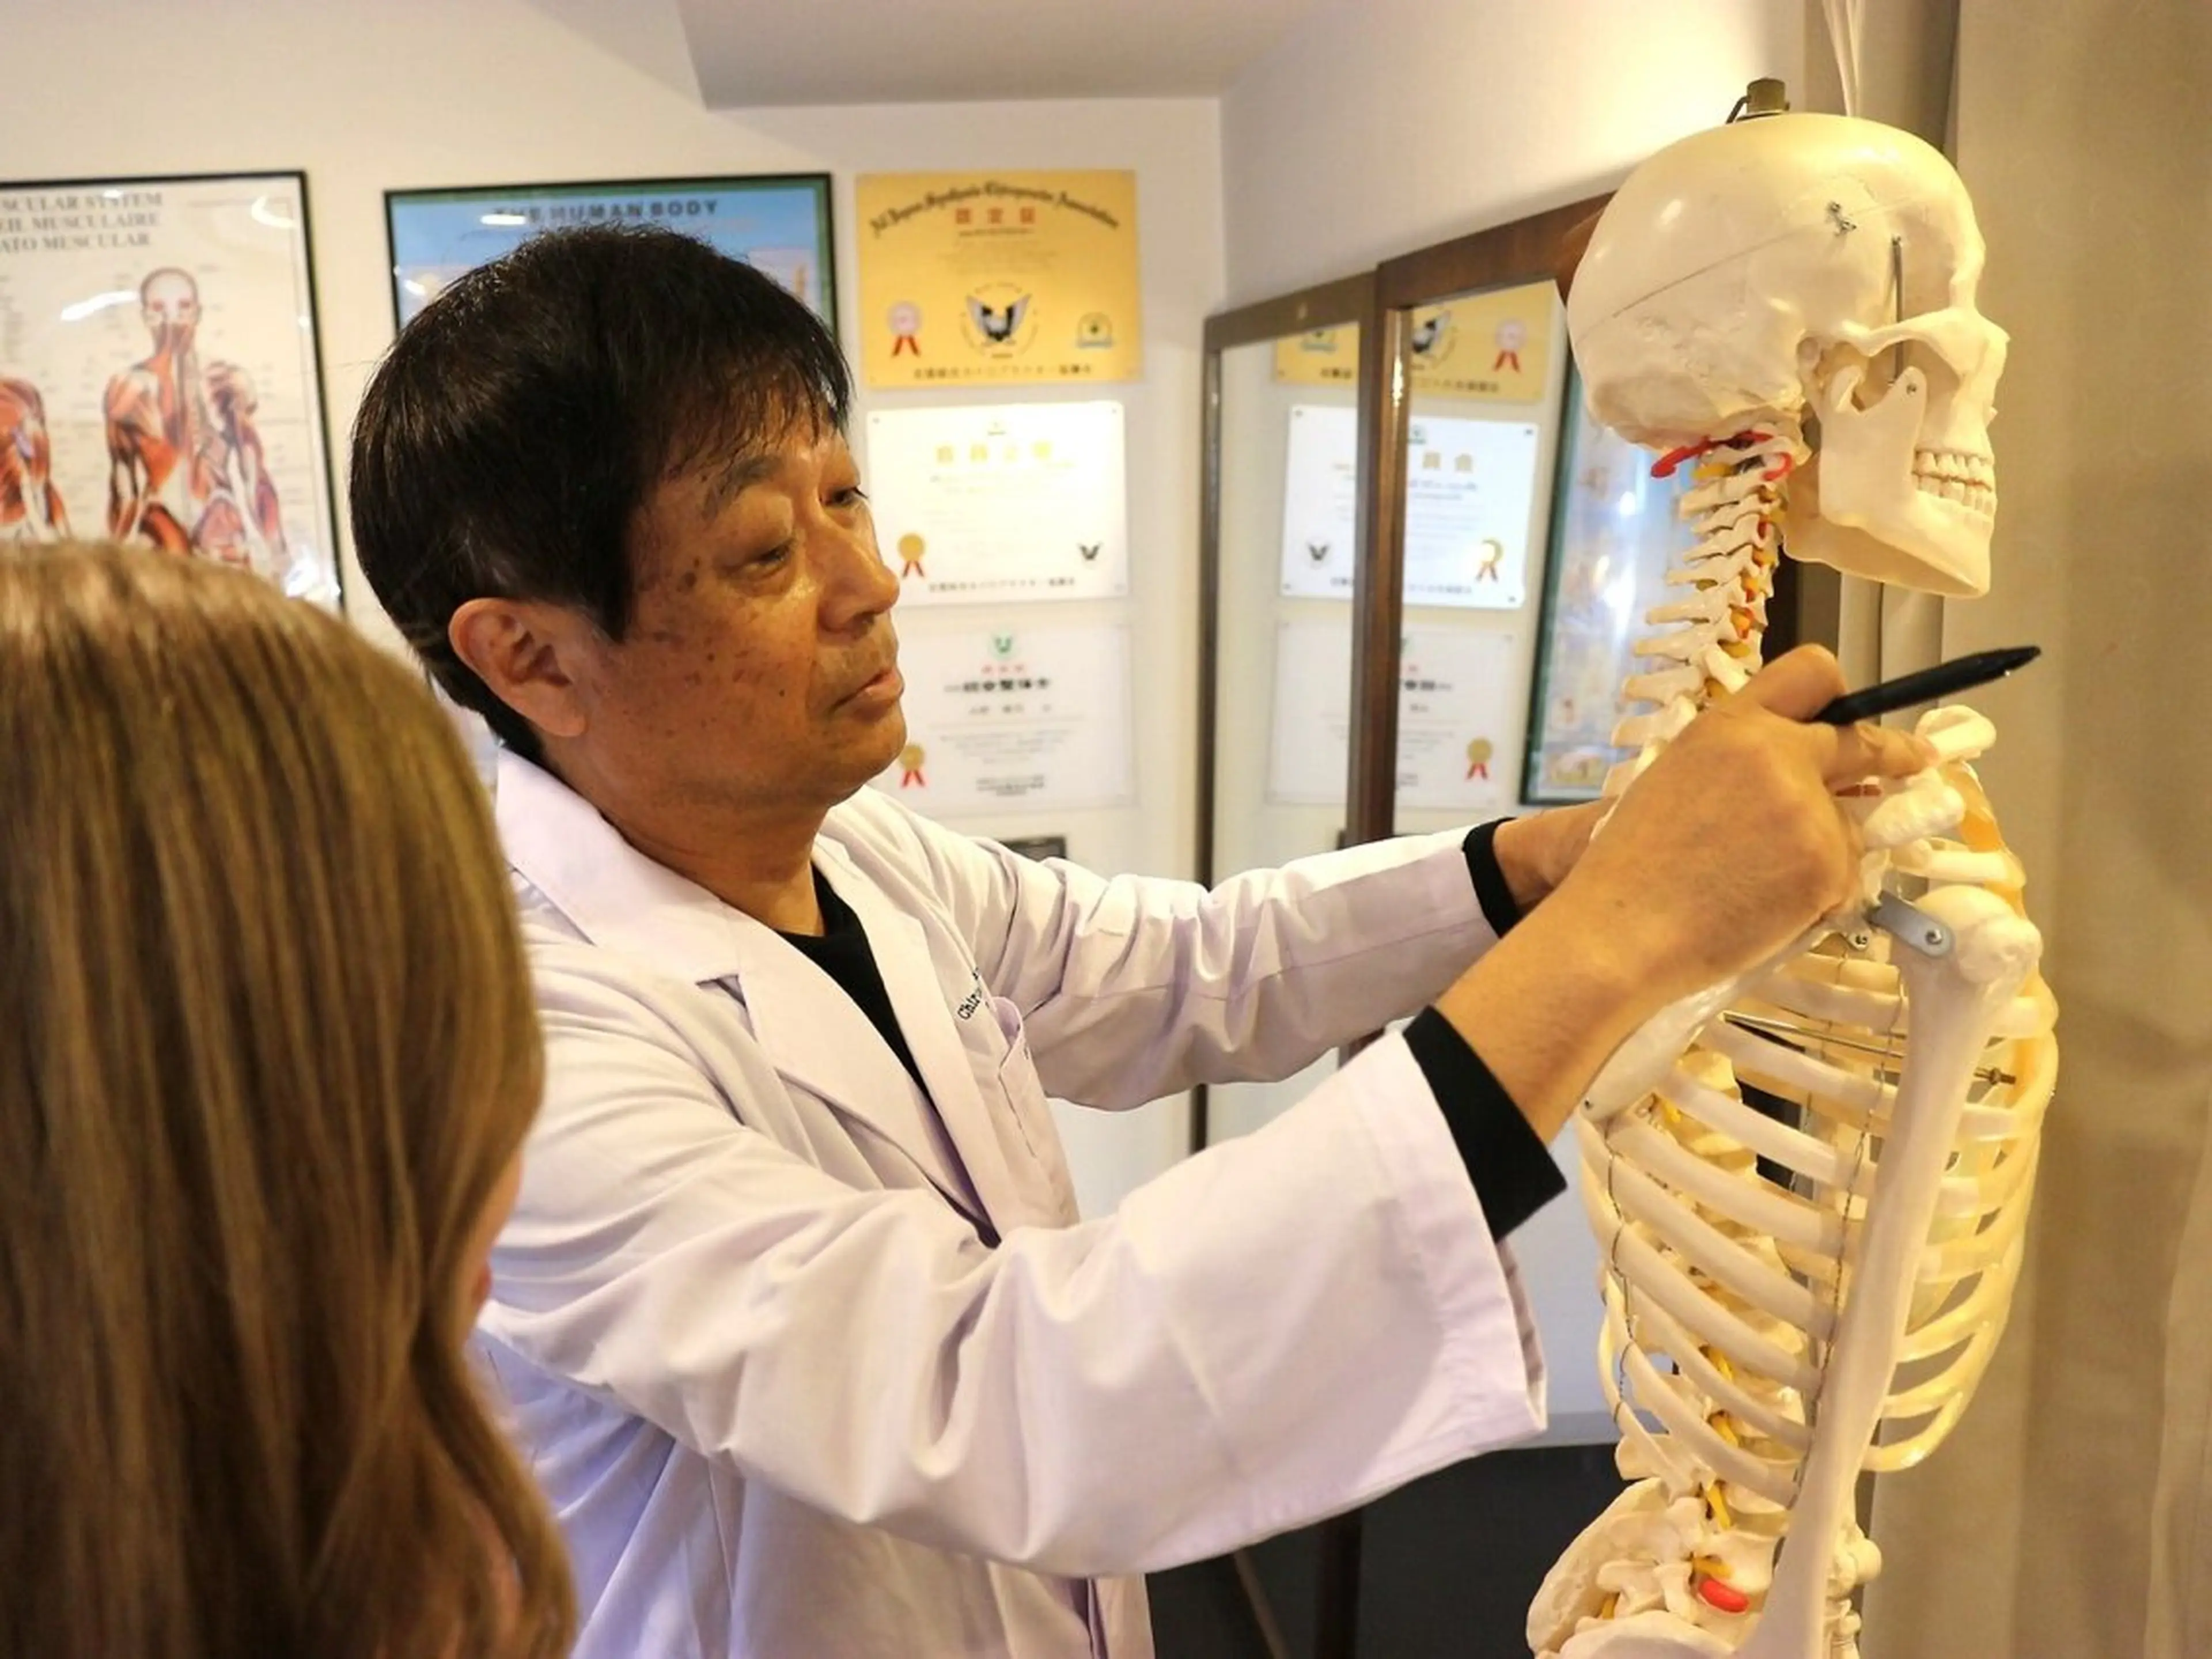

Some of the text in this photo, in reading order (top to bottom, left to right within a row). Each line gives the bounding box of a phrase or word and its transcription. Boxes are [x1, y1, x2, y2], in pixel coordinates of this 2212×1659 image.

[550, 202, 645, 221] HUMAN
[650, 199, 719, 217] BODY
[32, 213, 159, 229] MUSCULAIRE
[43, 234, 150, 249] MUSCULAR
